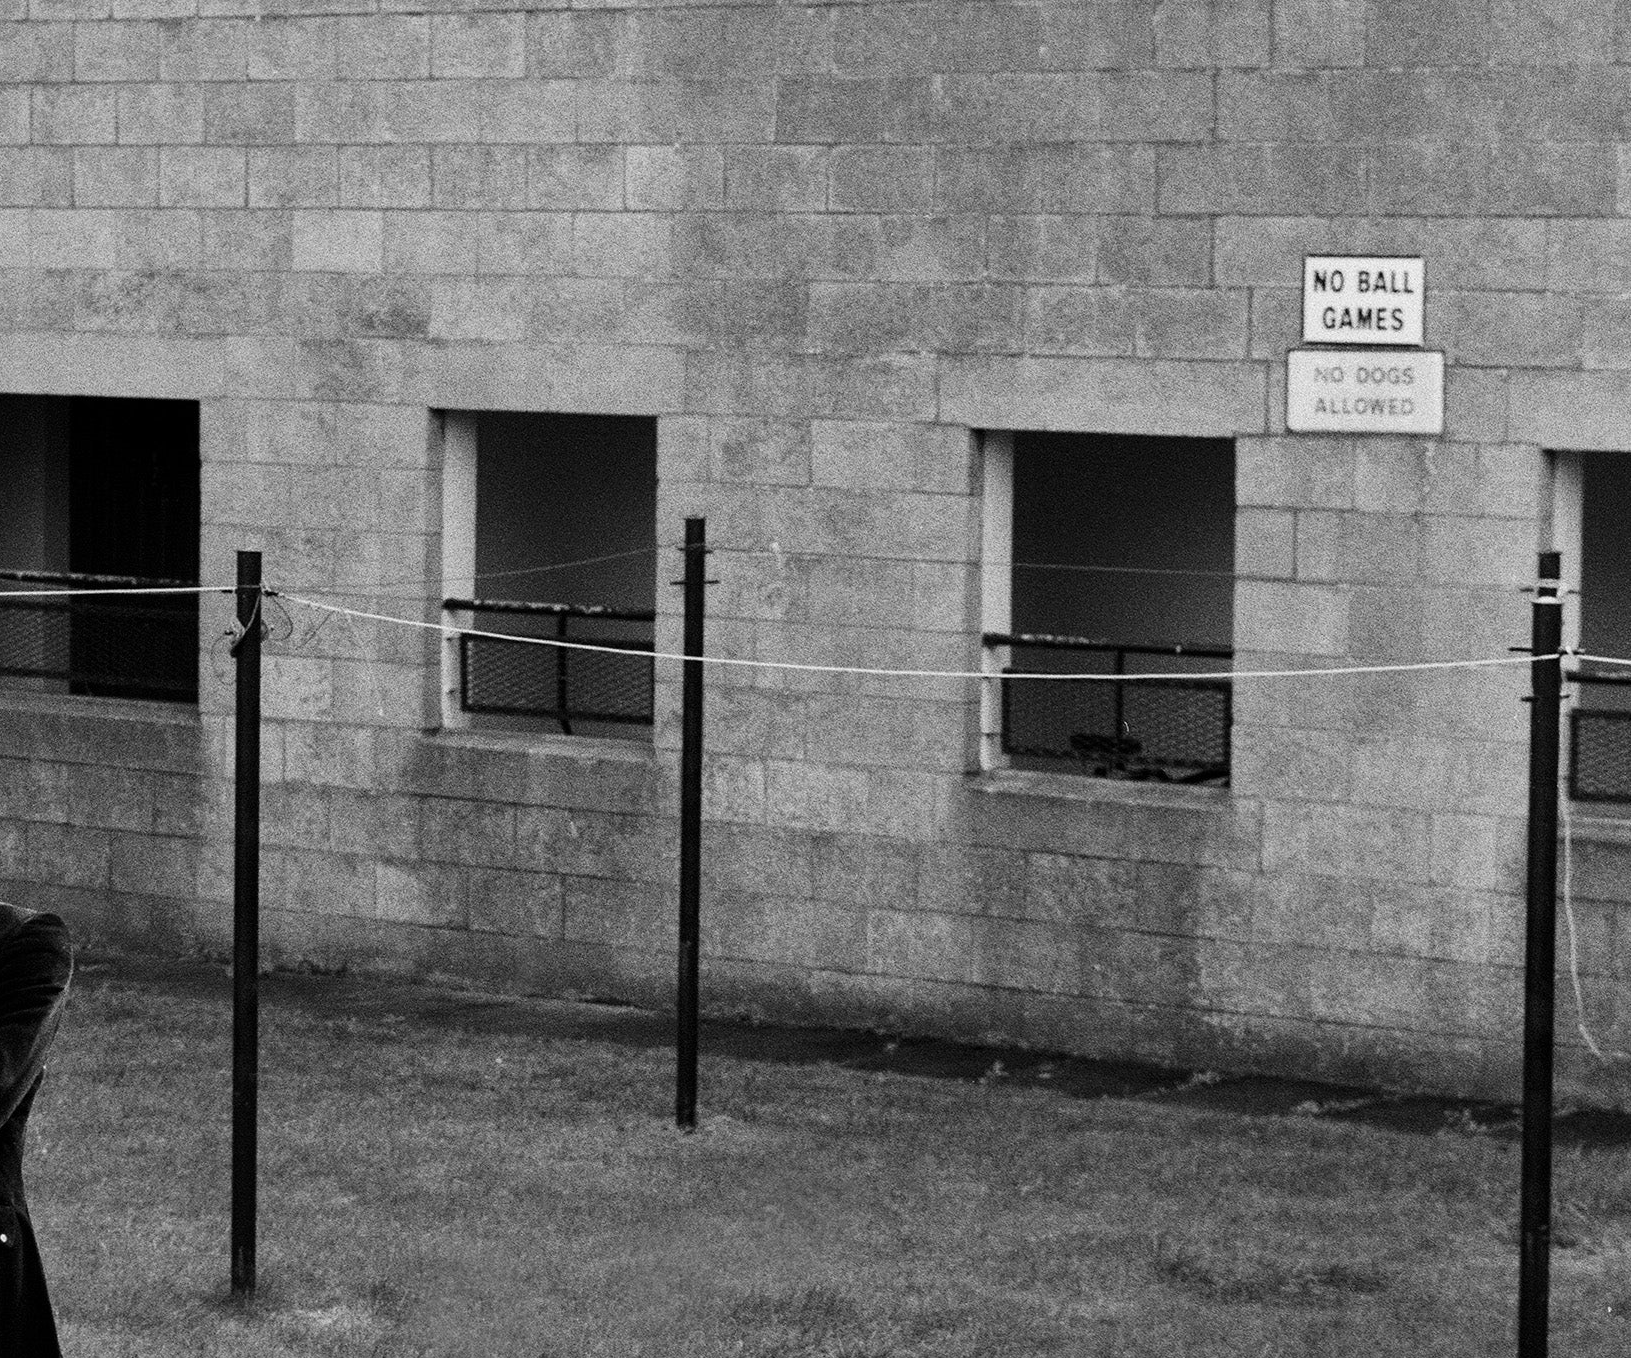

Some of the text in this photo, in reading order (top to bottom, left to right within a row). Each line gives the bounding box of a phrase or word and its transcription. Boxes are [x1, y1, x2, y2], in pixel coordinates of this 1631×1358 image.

[1313, 270, 1414, 294] NO BALL
[1322, 307, 1404, 331] GAMES
[1313, 366, 1415, 385] NO DOGS
[1314, 398, 1414, 416] ALLOWED
